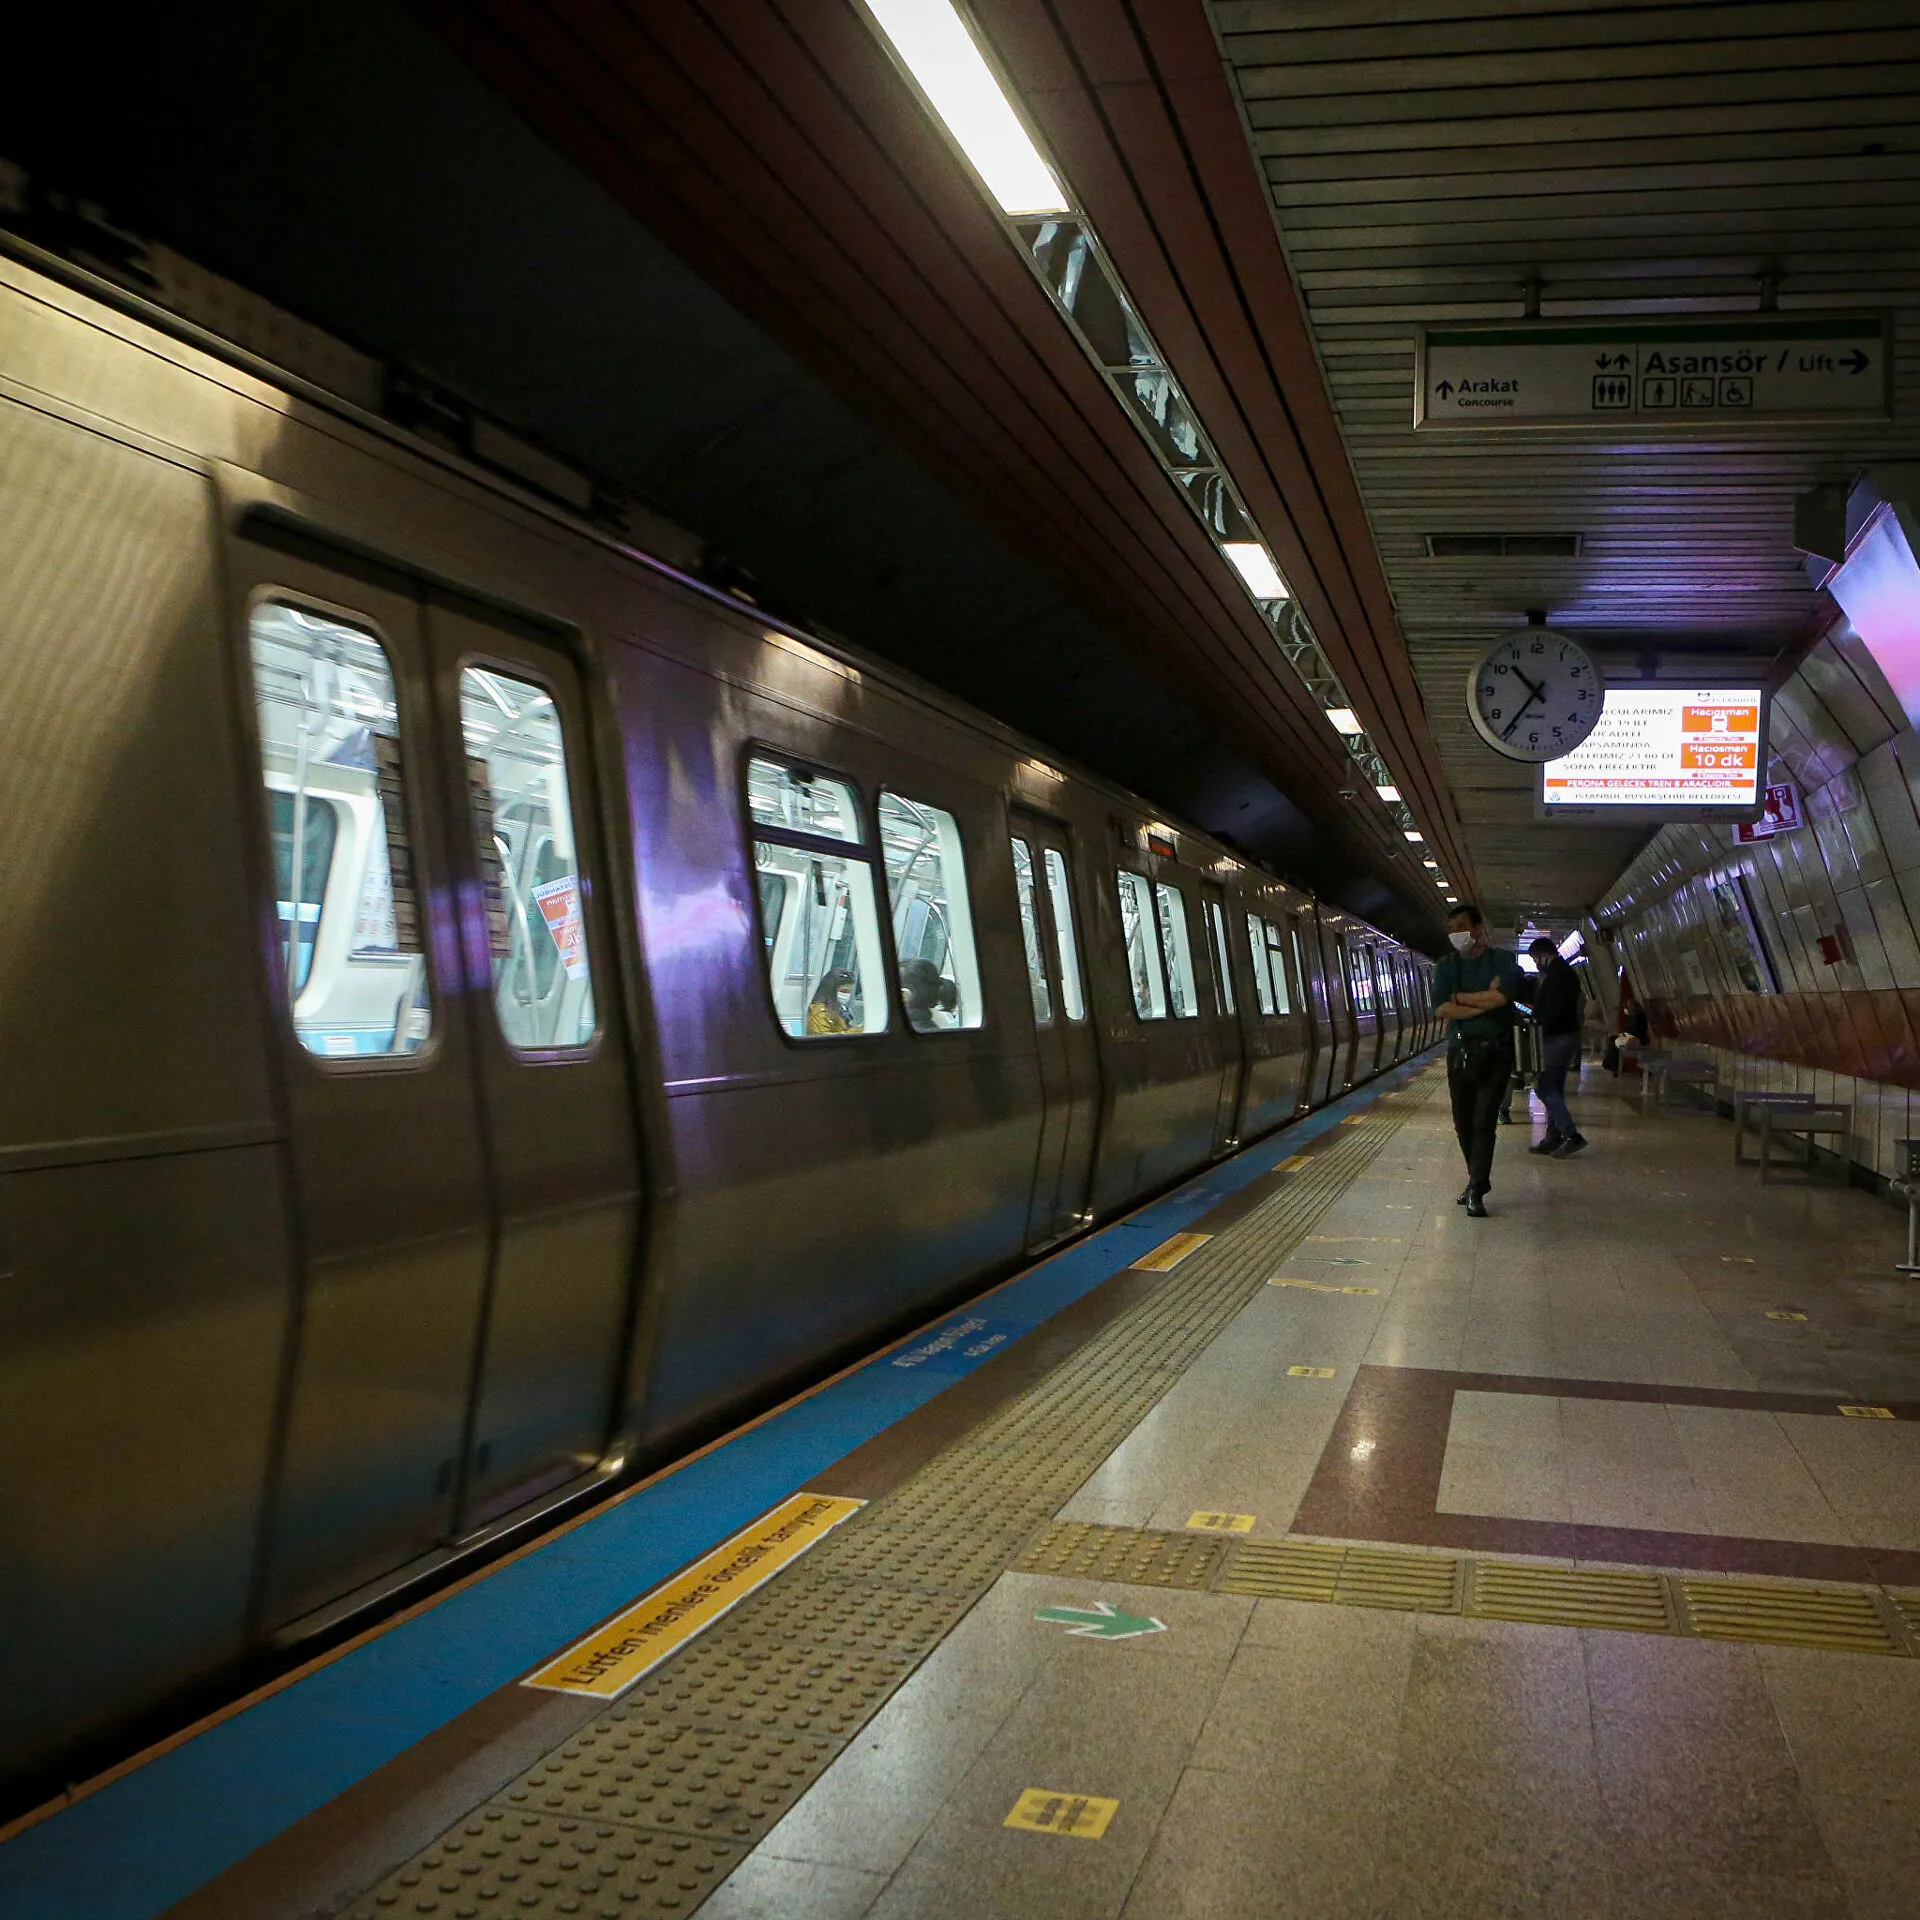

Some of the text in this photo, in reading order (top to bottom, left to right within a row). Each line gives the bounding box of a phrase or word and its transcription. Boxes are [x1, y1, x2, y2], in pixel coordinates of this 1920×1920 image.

[1644, 349, 1768, 374] Asansör
[1799, 354, 1834, 372] Lift
[1458, 377, 1519, 393] Arakat
[1458, 398, 1514, 408] Concourse
[1531, 642, 1544, 654] 12
[1512, 650, 1520, 659] 11
[1559, 650, 1564, 661] 1
[1494, 664, 1508, 675] 10
[1570, 666, 1581, 678] 2
[1485, 686, 1495, 697] 9
[1577, 689, 1587, 701] 3
[1491, 708, 1502, 720] 8
[1567, 712, 1578, 723] 4
[1528, 732, 1539, 743] 6
[1552, 726, 1562, 738] 5
[1694, 753, 1743, 767] 10 dk
[1567, 780, 1605, 788] PERONA
[1607, 780, 1647, 788] GELECEK
[1648, 780, 1672, 788] TREN
[560, 1637, 648, 1685] Lütfen
[628, 1584, 720, 1636] inenlere
